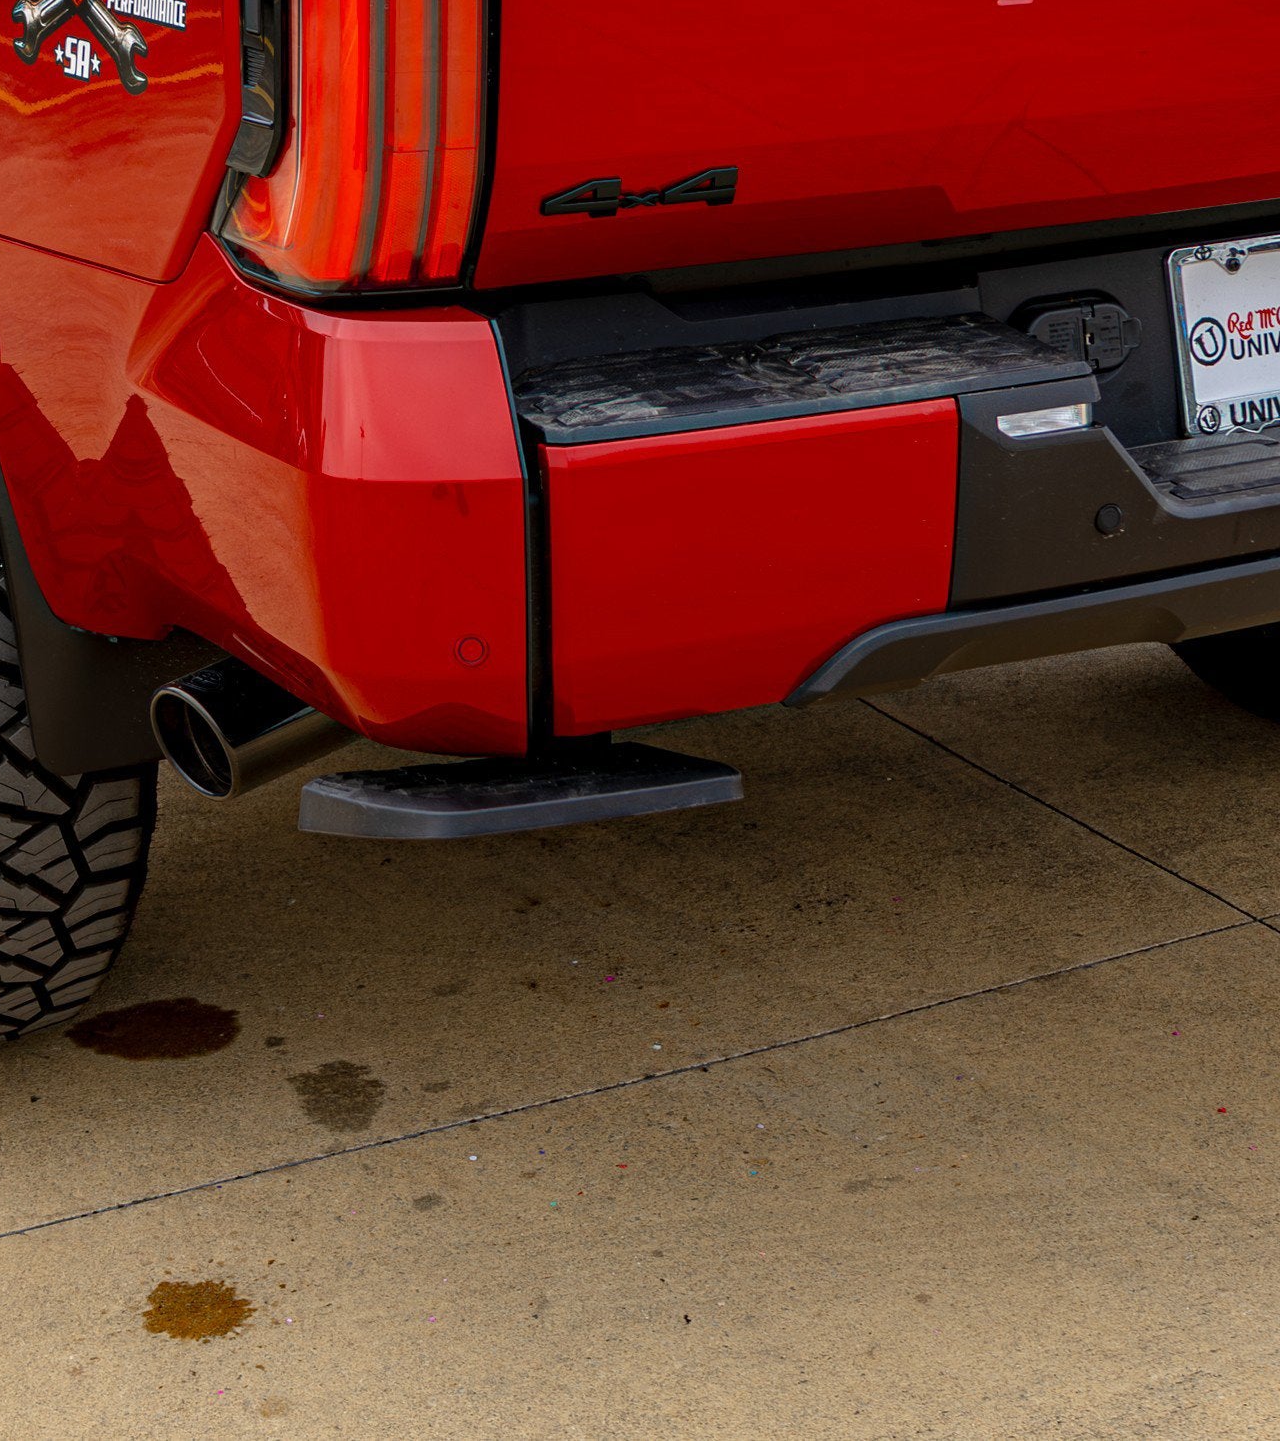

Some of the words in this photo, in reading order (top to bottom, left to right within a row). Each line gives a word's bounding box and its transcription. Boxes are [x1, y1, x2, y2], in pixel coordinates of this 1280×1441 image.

[63, 36, 91, 80] SA
[540, 166, 739, 219] 4x4
[1227, 312, 1254, 340] Red
